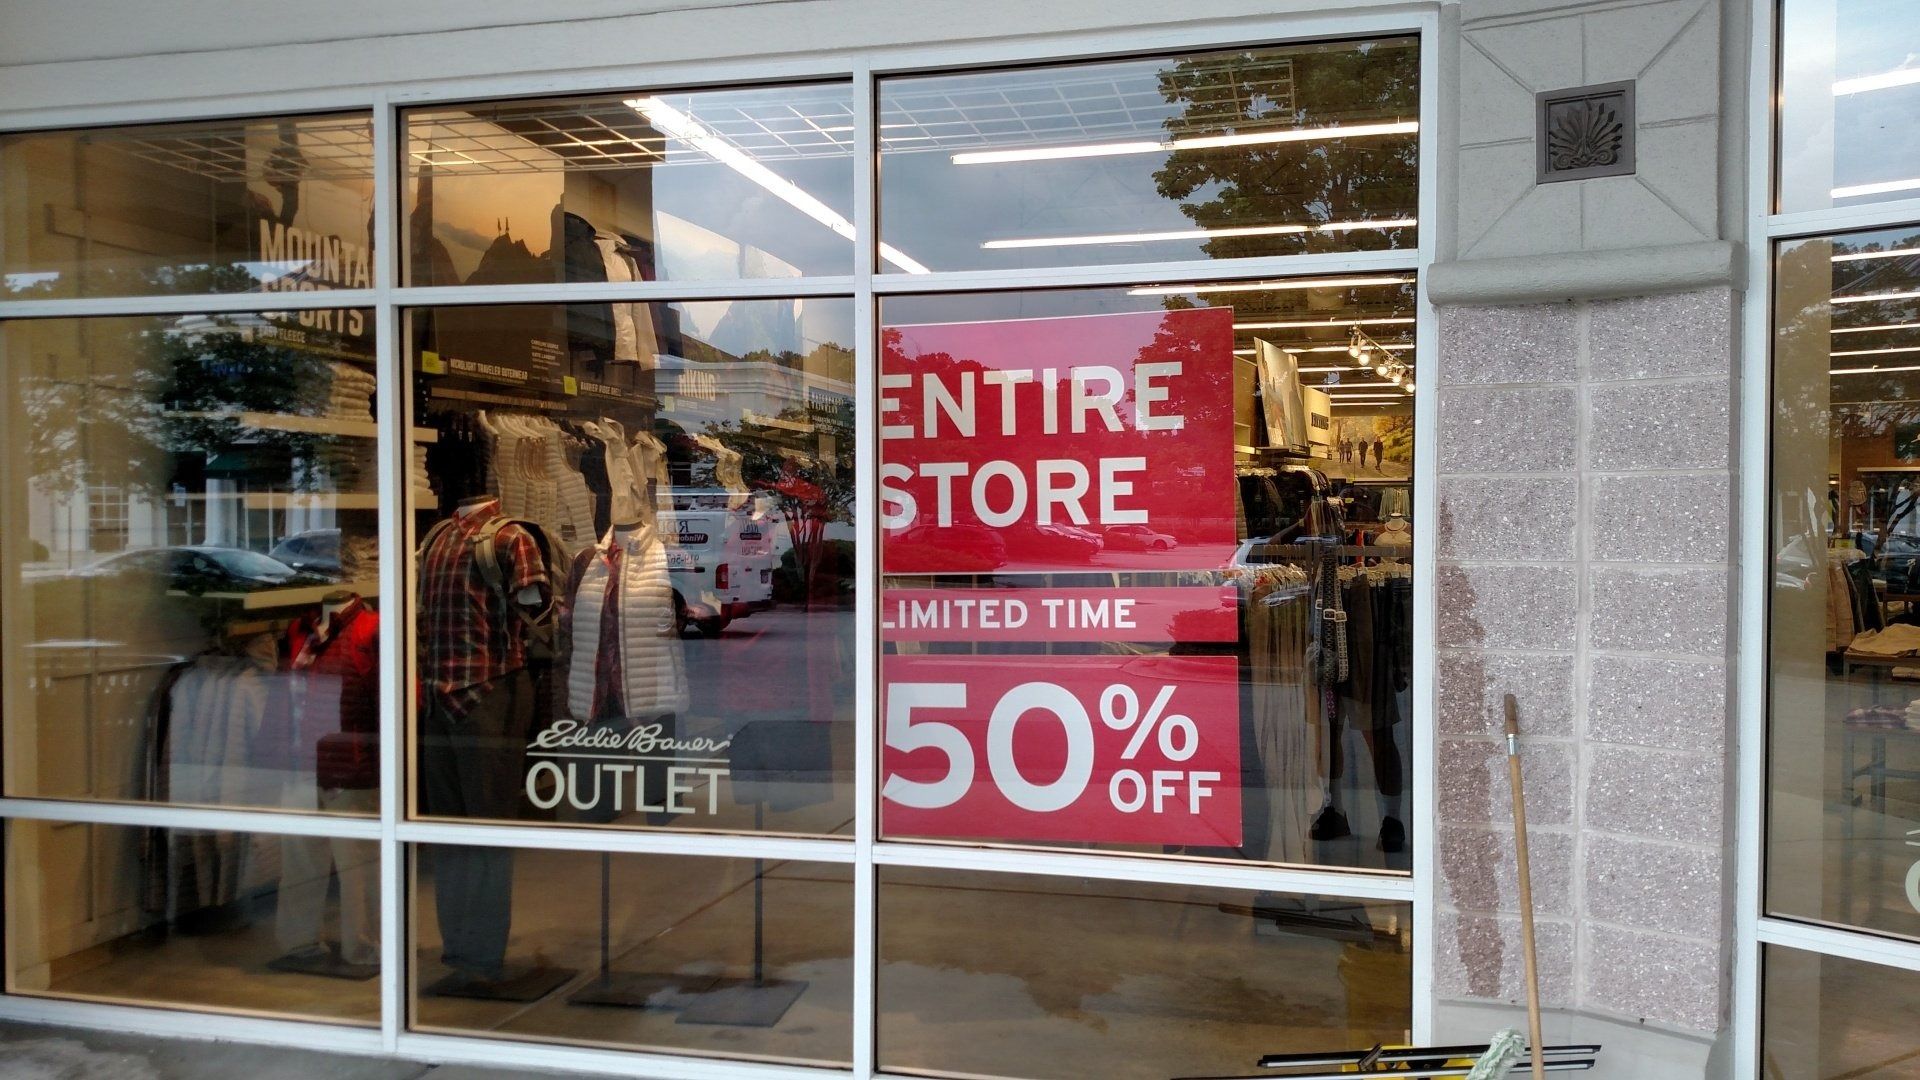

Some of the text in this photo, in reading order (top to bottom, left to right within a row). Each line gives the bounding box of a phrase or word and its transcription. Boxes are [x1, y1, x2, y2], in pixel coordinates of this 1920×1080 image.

[882, 361, 1185, 440] ENTIRE
[882, 456, 1149, 530] STORE
[1041, 598, 1137, 629] TIME
[527, 719, 731, 753] Eddie Bauer
[881, 681, 1199, 813] 50%
[525, 760, 731, 815] OUTLET
[1109, 769, 1222, 815] OFF
